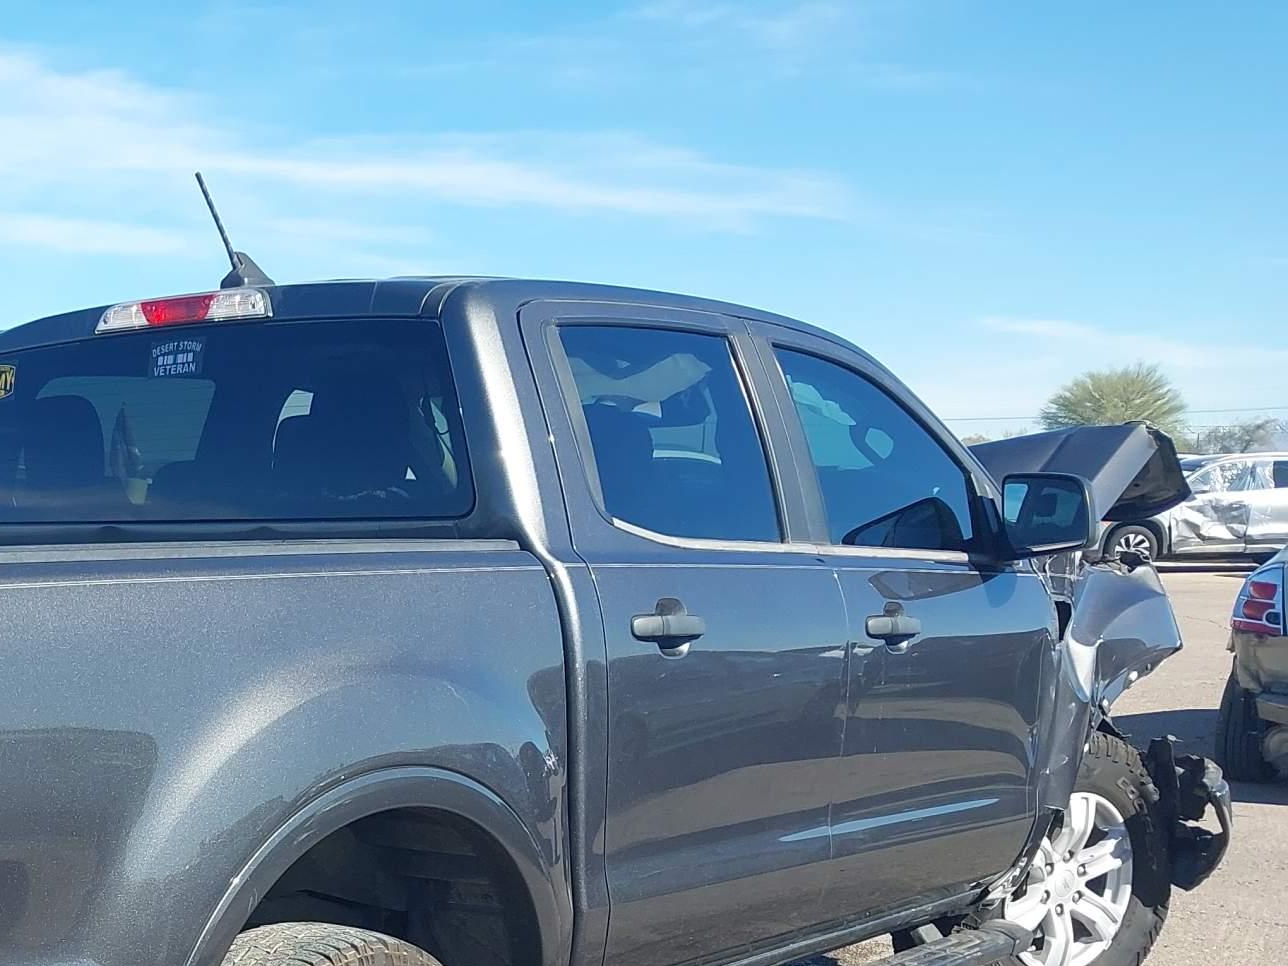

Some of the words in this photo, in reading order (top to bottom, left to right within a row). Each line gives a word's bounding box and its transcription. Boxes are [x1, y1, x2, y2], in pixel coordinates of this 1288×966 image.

[152, 343, 179, 358] DESERT
[179, 341, 202, 352] STORM
[154, 362, 196, 377] VETERAN
